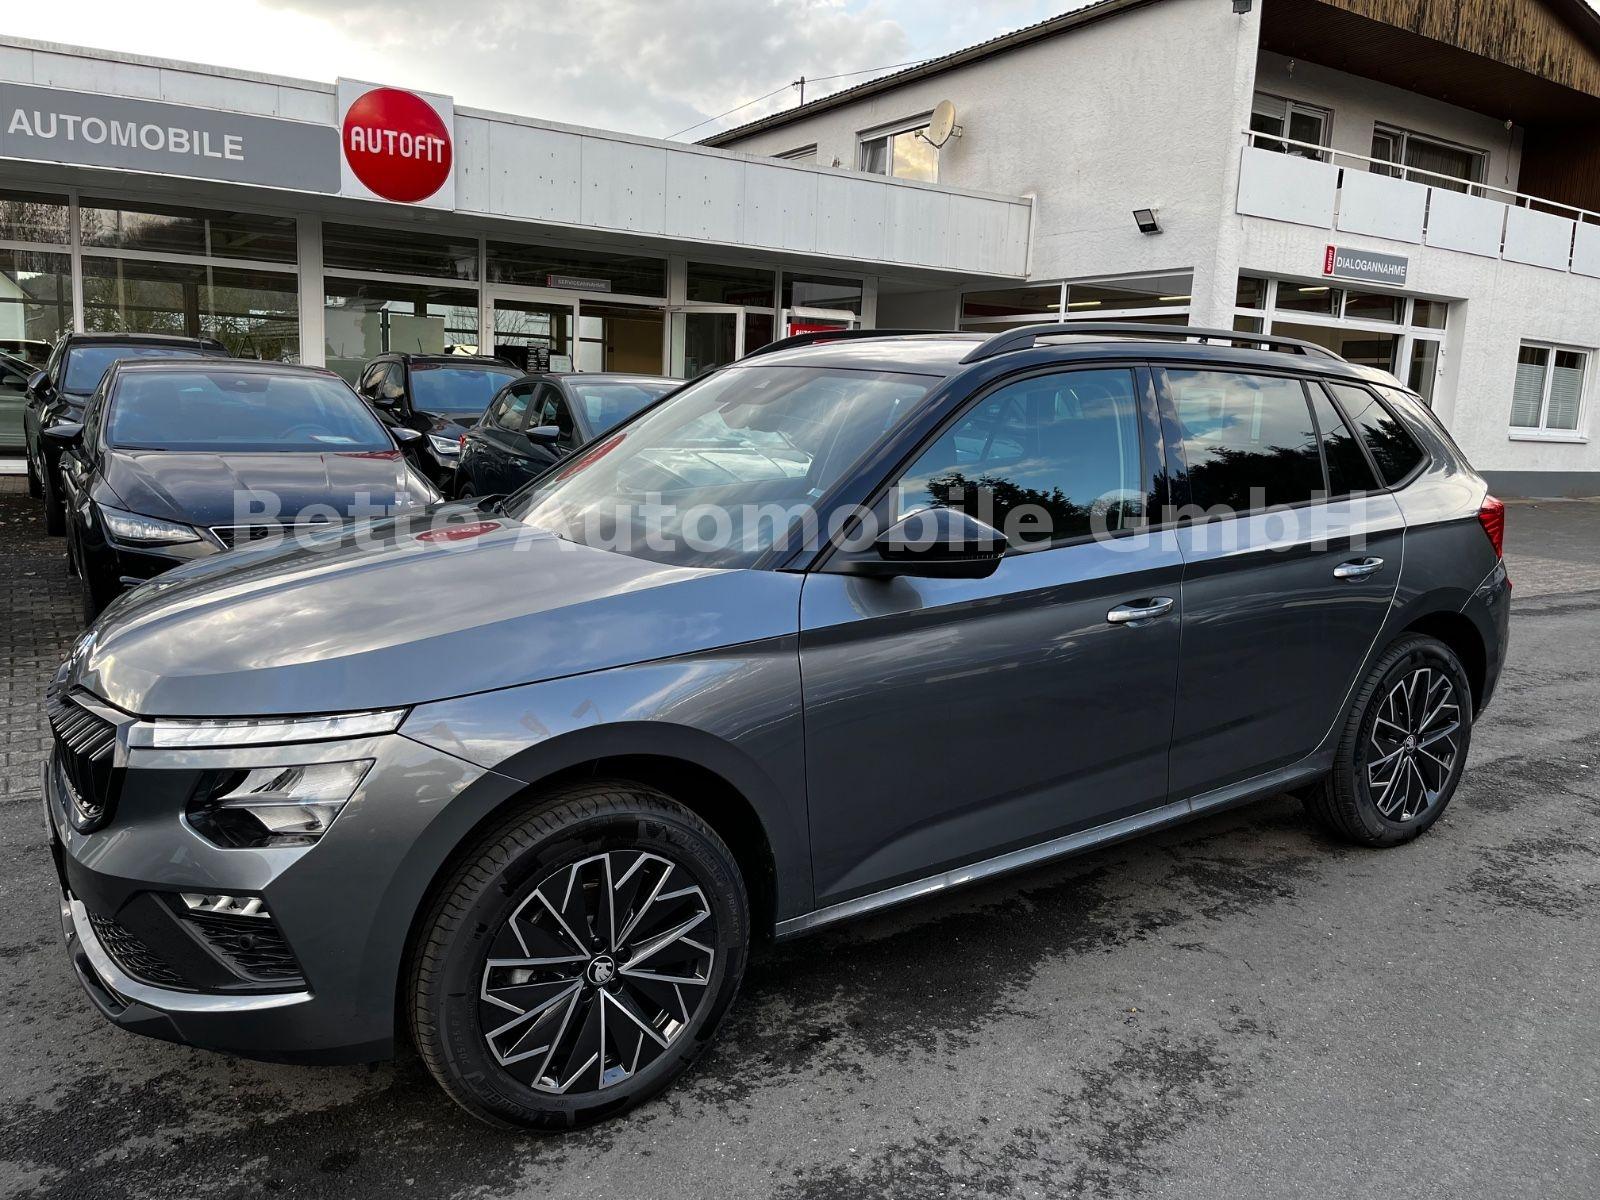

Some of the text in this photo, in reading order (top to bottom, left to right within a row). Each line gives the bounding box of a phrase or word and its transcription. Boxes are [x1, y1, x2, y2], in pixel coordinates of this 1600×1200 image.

[8, 109, 244, 161] AUTOMOBILE
[351, 126, 445, 163] AUTOFIT
[1336, 256, 1406, 277] DIALOGANNAHME
